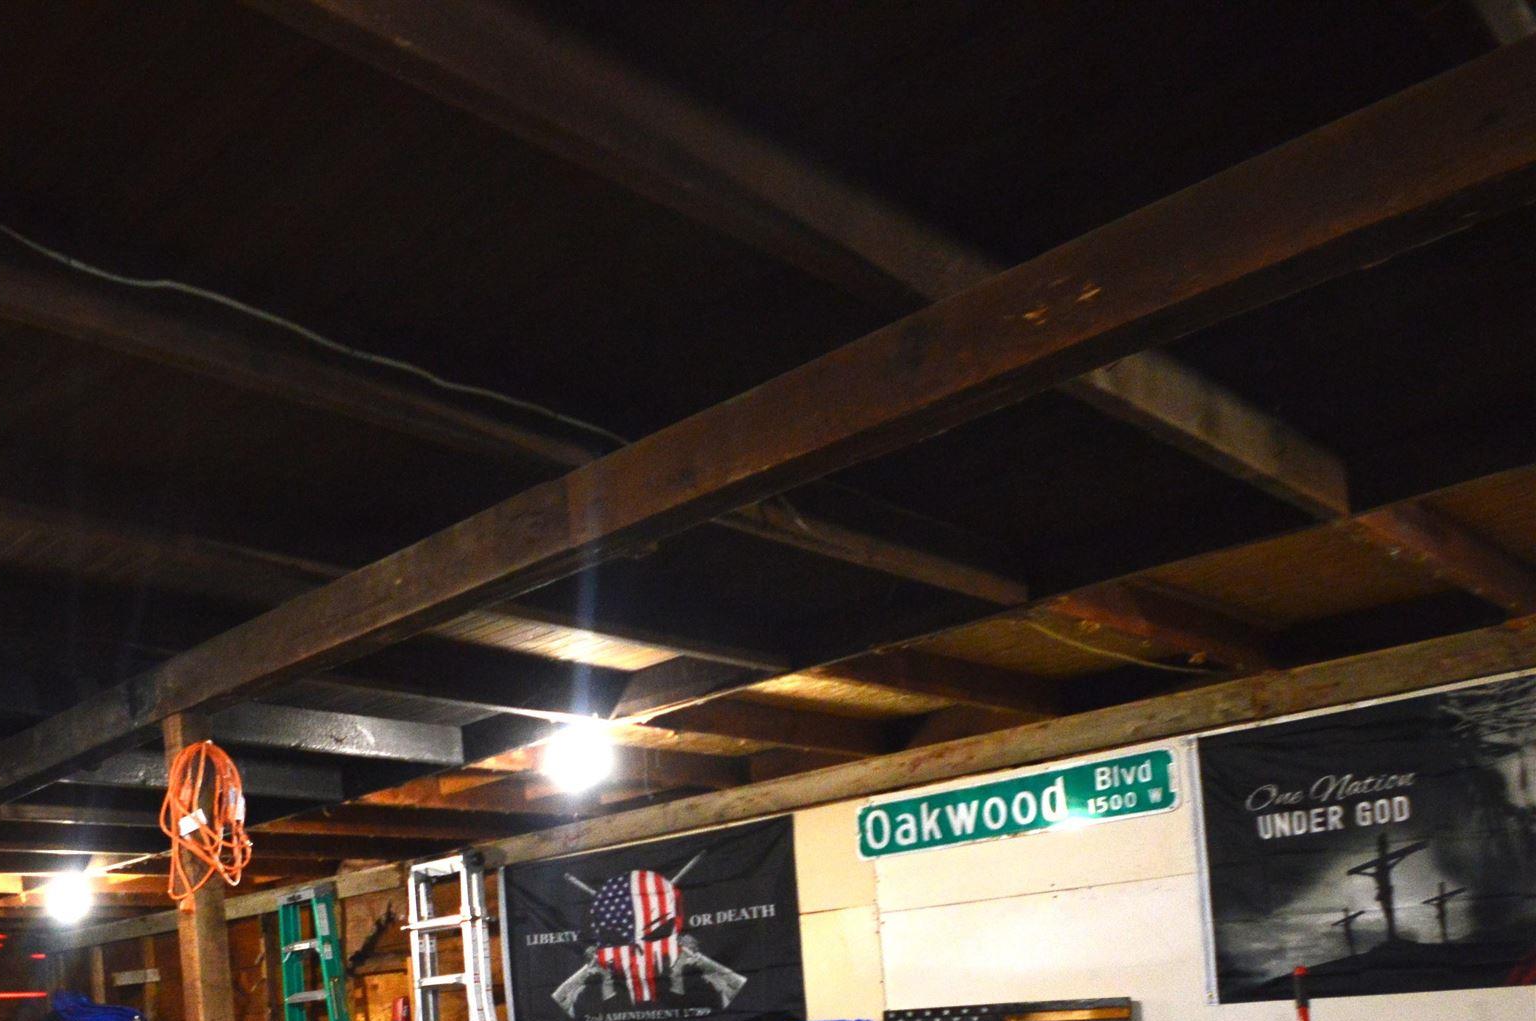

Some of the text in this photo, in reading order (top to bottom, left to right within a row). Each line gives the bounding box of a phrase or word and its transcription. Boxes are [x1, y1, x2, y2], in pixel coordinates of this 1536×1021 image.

[864, 759, 1153, 850] Oakwood Blvd
[1086, 787, 1163, 815] 1500 W
[1245, 771, 1417, 812] One Nation
[1256, 795, 1411, 840] UNDER GOD
[526, 903, 776, 946] LIBERTY OR DEATH
[605, 1009, 680, 1021] AMENDMENT
